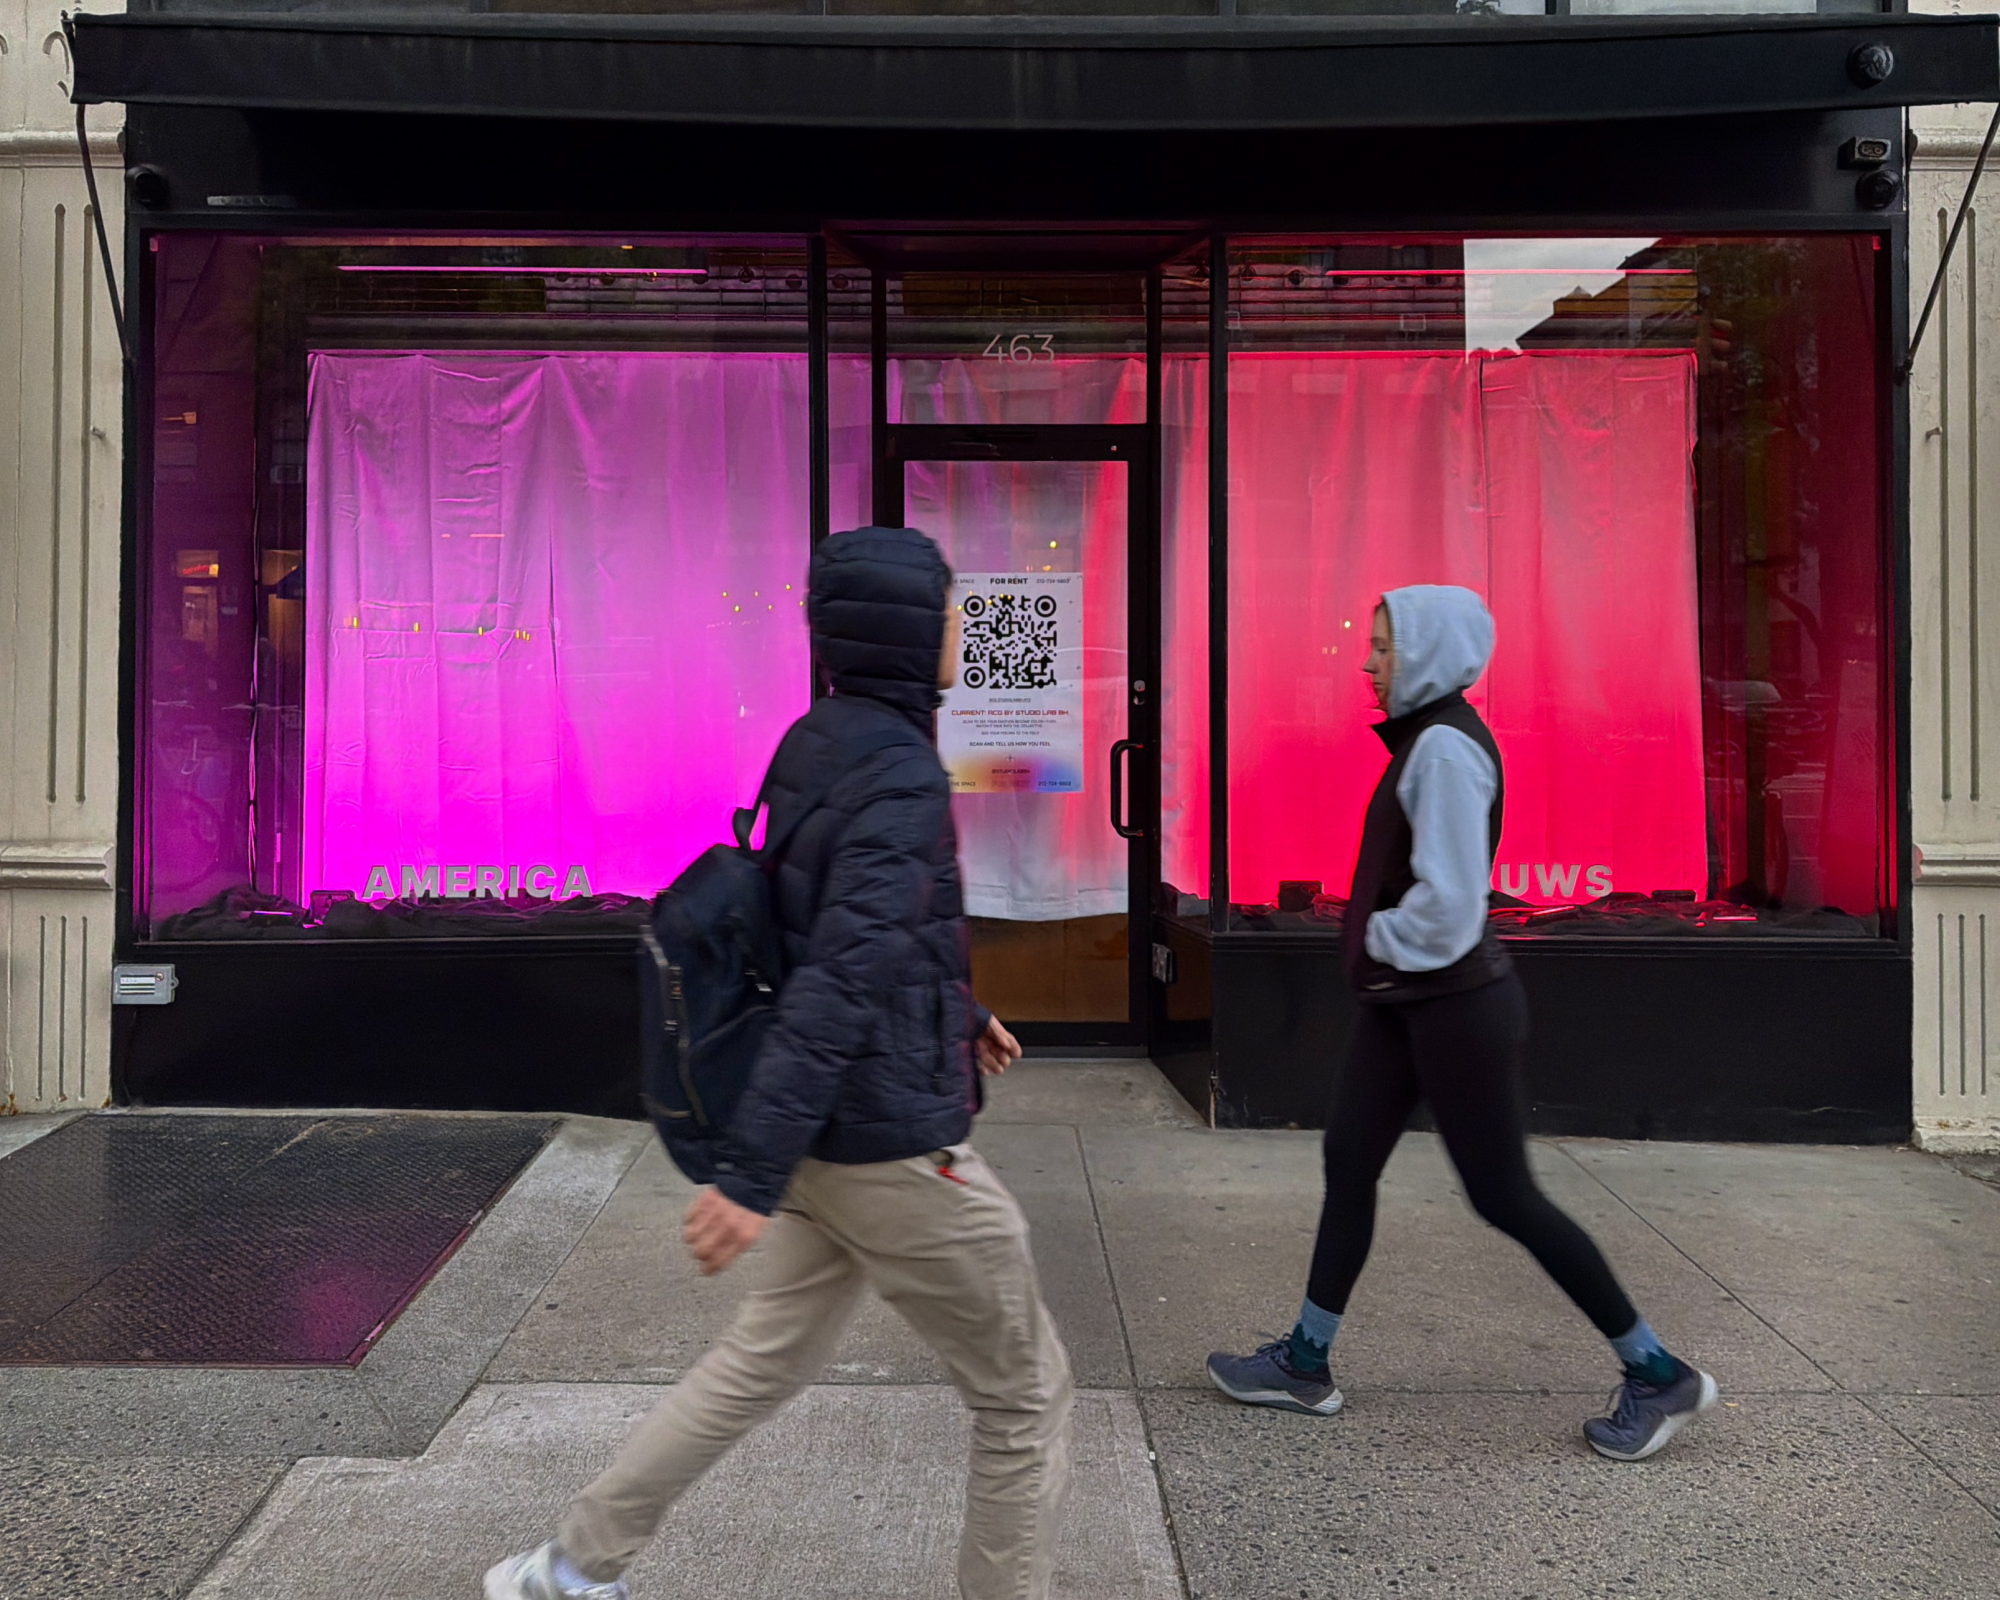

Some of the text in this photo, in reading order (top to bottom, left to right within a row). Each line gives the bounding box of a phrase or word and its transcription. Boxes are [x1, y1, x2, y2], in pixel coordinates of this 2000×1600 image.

[982, 334, 1055, 365] 463
[362, 864, 593, 898] AMERICA
[1500, 863, 1613, 898] UWS
